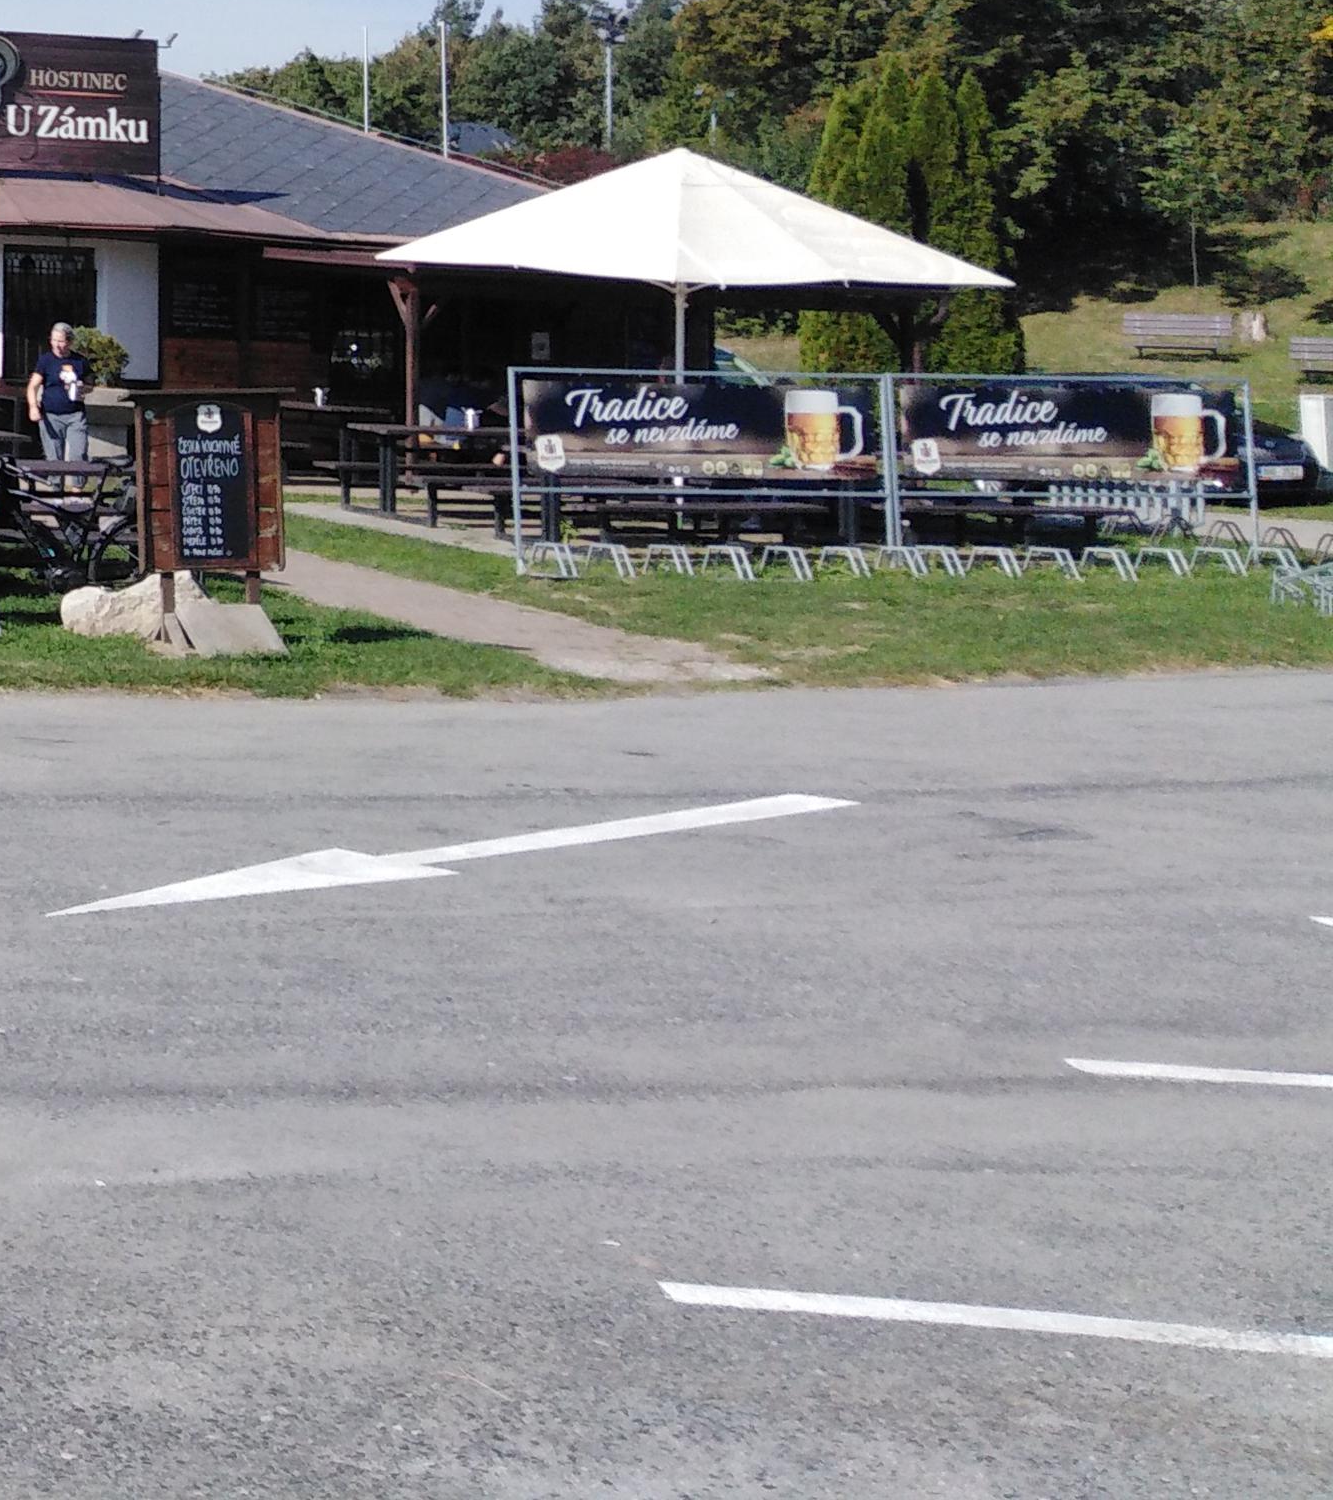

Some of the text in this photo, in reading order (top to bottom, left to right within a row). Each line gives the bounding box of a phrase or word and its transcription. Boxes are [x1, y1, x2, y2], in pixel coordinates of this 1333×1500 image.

[29, 68, 127, 91] HOSTINEC
[5, 104, 150, 143] U Zámku
[565, 386, 689, 429] Tradice
[939, 389, 1059, 432] Tradice
[604, 417, 740, 445] se nevzdáme
[977, 420, 1108, 448] se nevzdáme
[180, 454, 239, 479] OTEVŘENO
